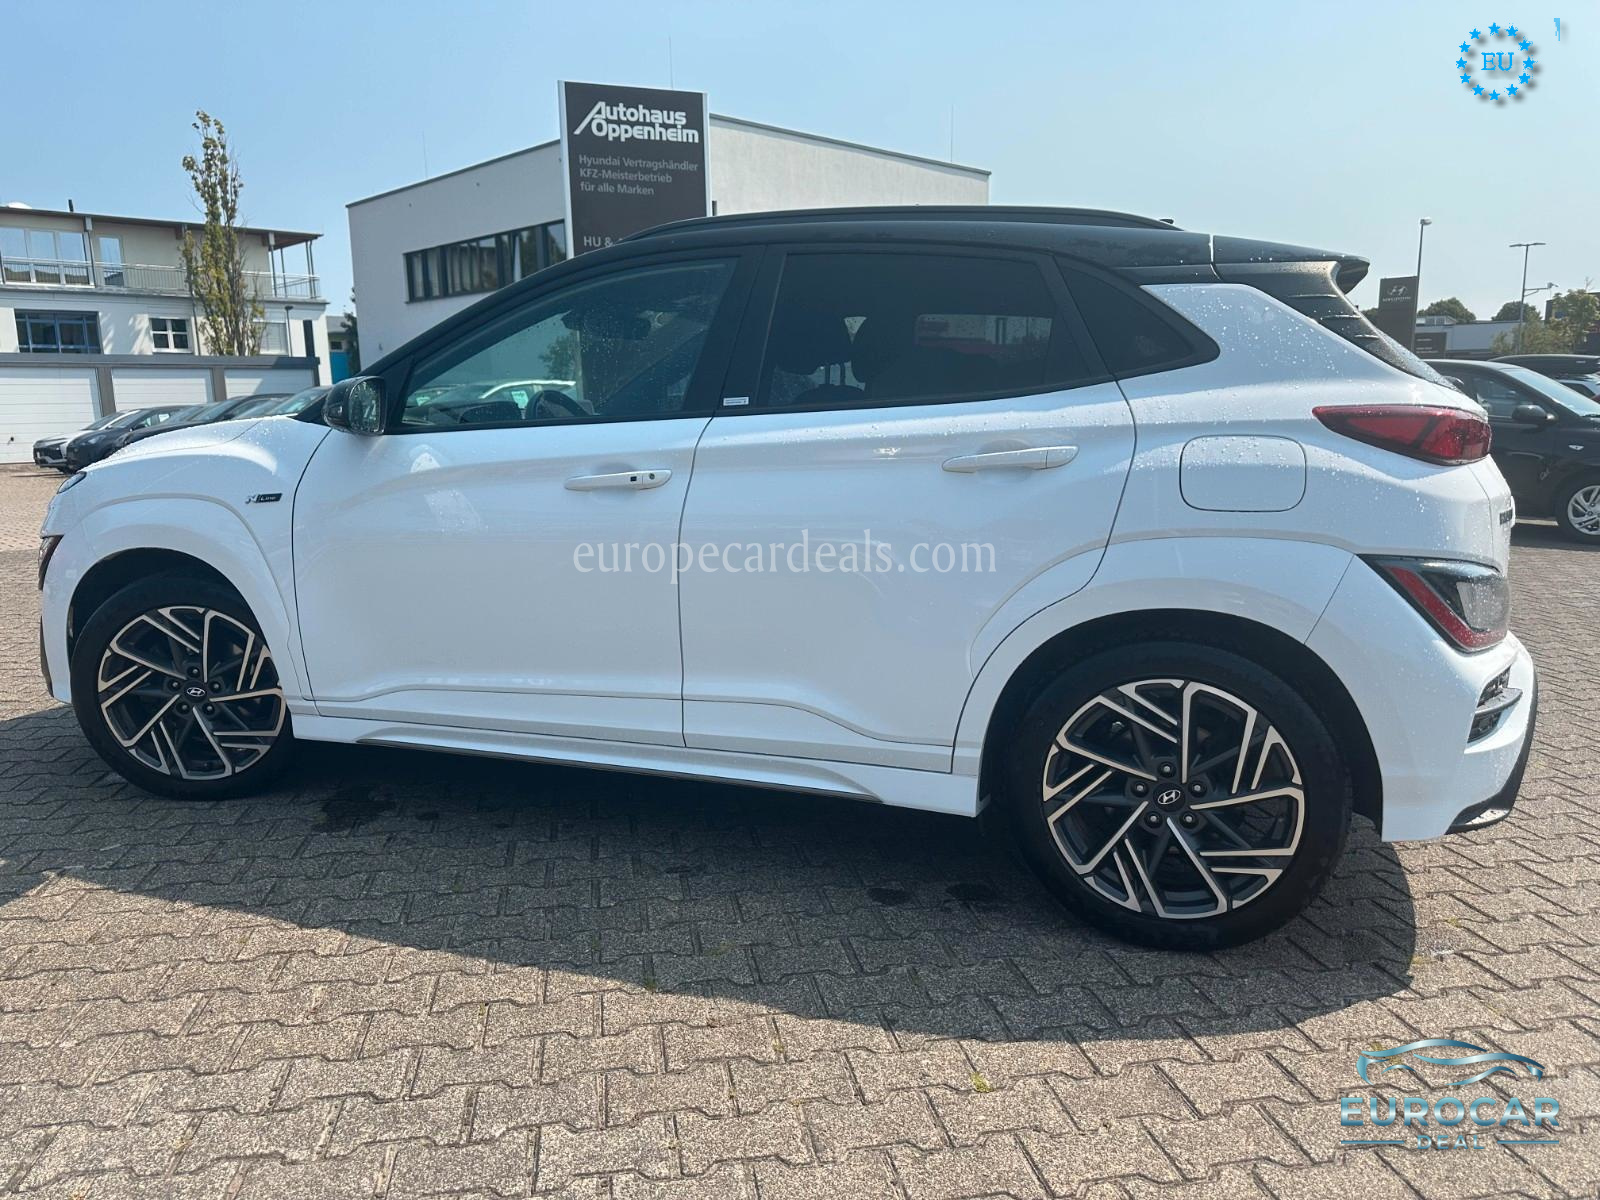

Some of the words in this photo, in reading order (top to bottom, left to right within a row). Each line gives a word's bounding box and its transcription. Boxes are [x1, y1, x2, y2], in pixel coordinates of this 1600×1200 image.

[574, 101, 687, 135] Autohaus
[591, 118, 700, 144] Oppenheim
[578, 154, 621, 167] Hyundai
[622, 156, 699, 172] Vertragshändler
[579, 168, 673, 183] KFZ-Meisterbetrieb
[580, 181, 595, 192] für
[597, 182, 615, 193] alle
[617, 184, 655, 196] Marken
[583, 235, 601, 248] HU
